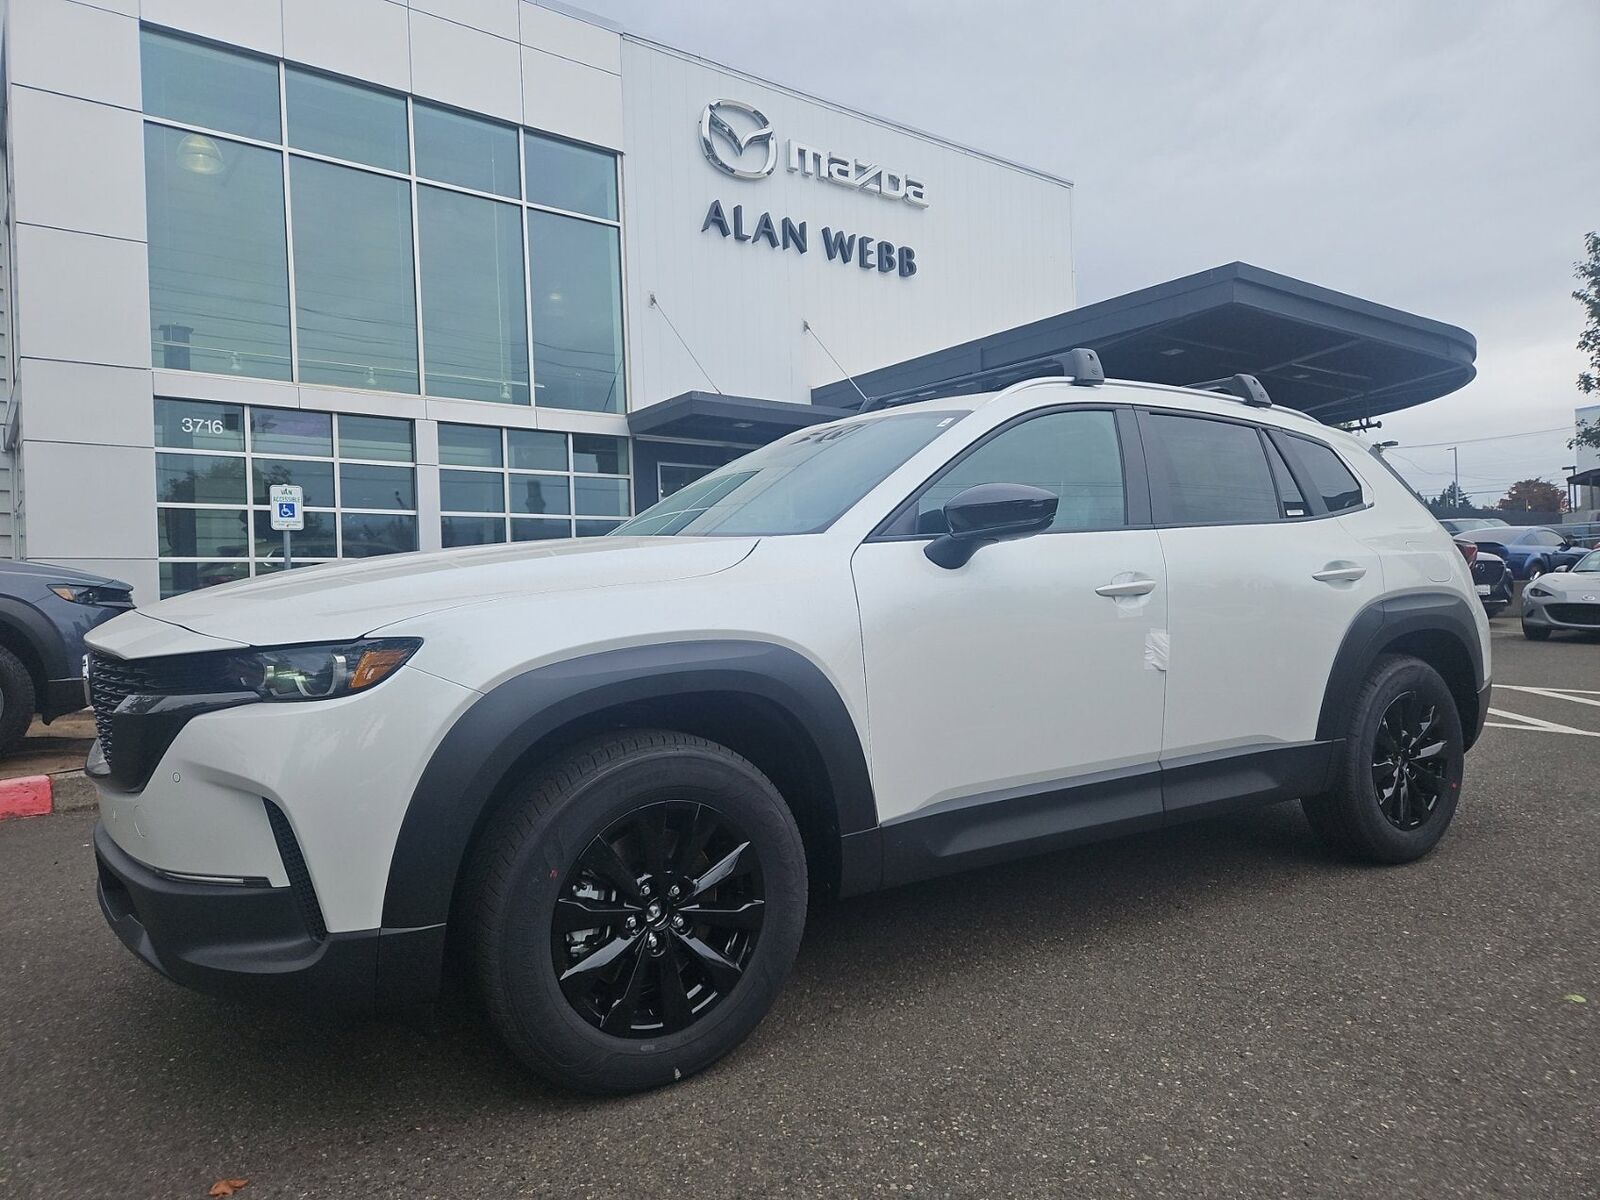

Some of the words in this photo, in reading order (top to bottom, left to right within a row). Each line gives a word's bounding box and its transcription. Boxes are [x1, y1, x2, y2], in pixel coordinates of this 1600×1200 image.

[701, 199, 808, 255] ALAN
[821, 226, 918, 278] WEBB
[181, 417, 224, 435] 3716
